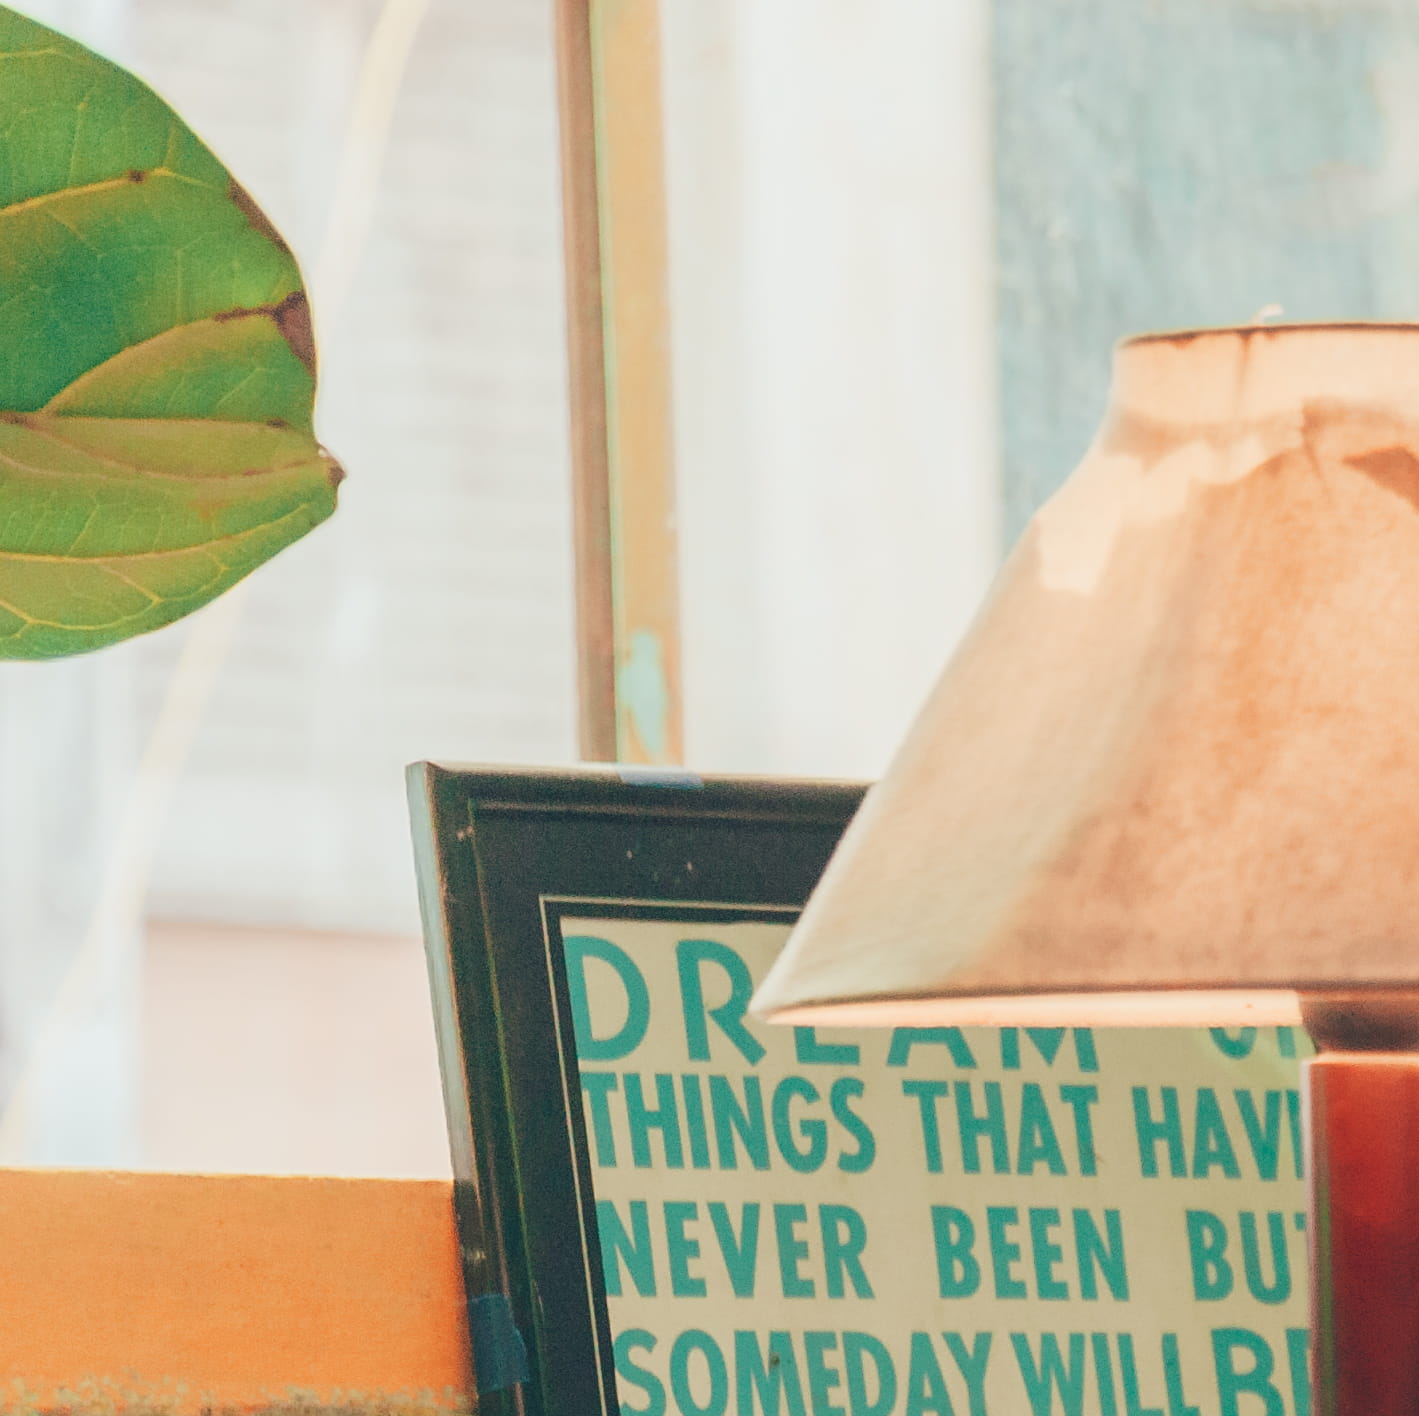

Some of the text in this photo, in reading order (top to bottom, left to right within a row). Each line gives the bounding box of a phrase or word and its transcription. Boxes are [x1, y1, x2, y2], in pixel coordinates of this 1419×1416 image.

[580, 1071, 876, 1174] THINGS
[902, 1079, 1099, 1177] THAT
[596, 1199, 1307, 1305] NEVER BEEN BU
